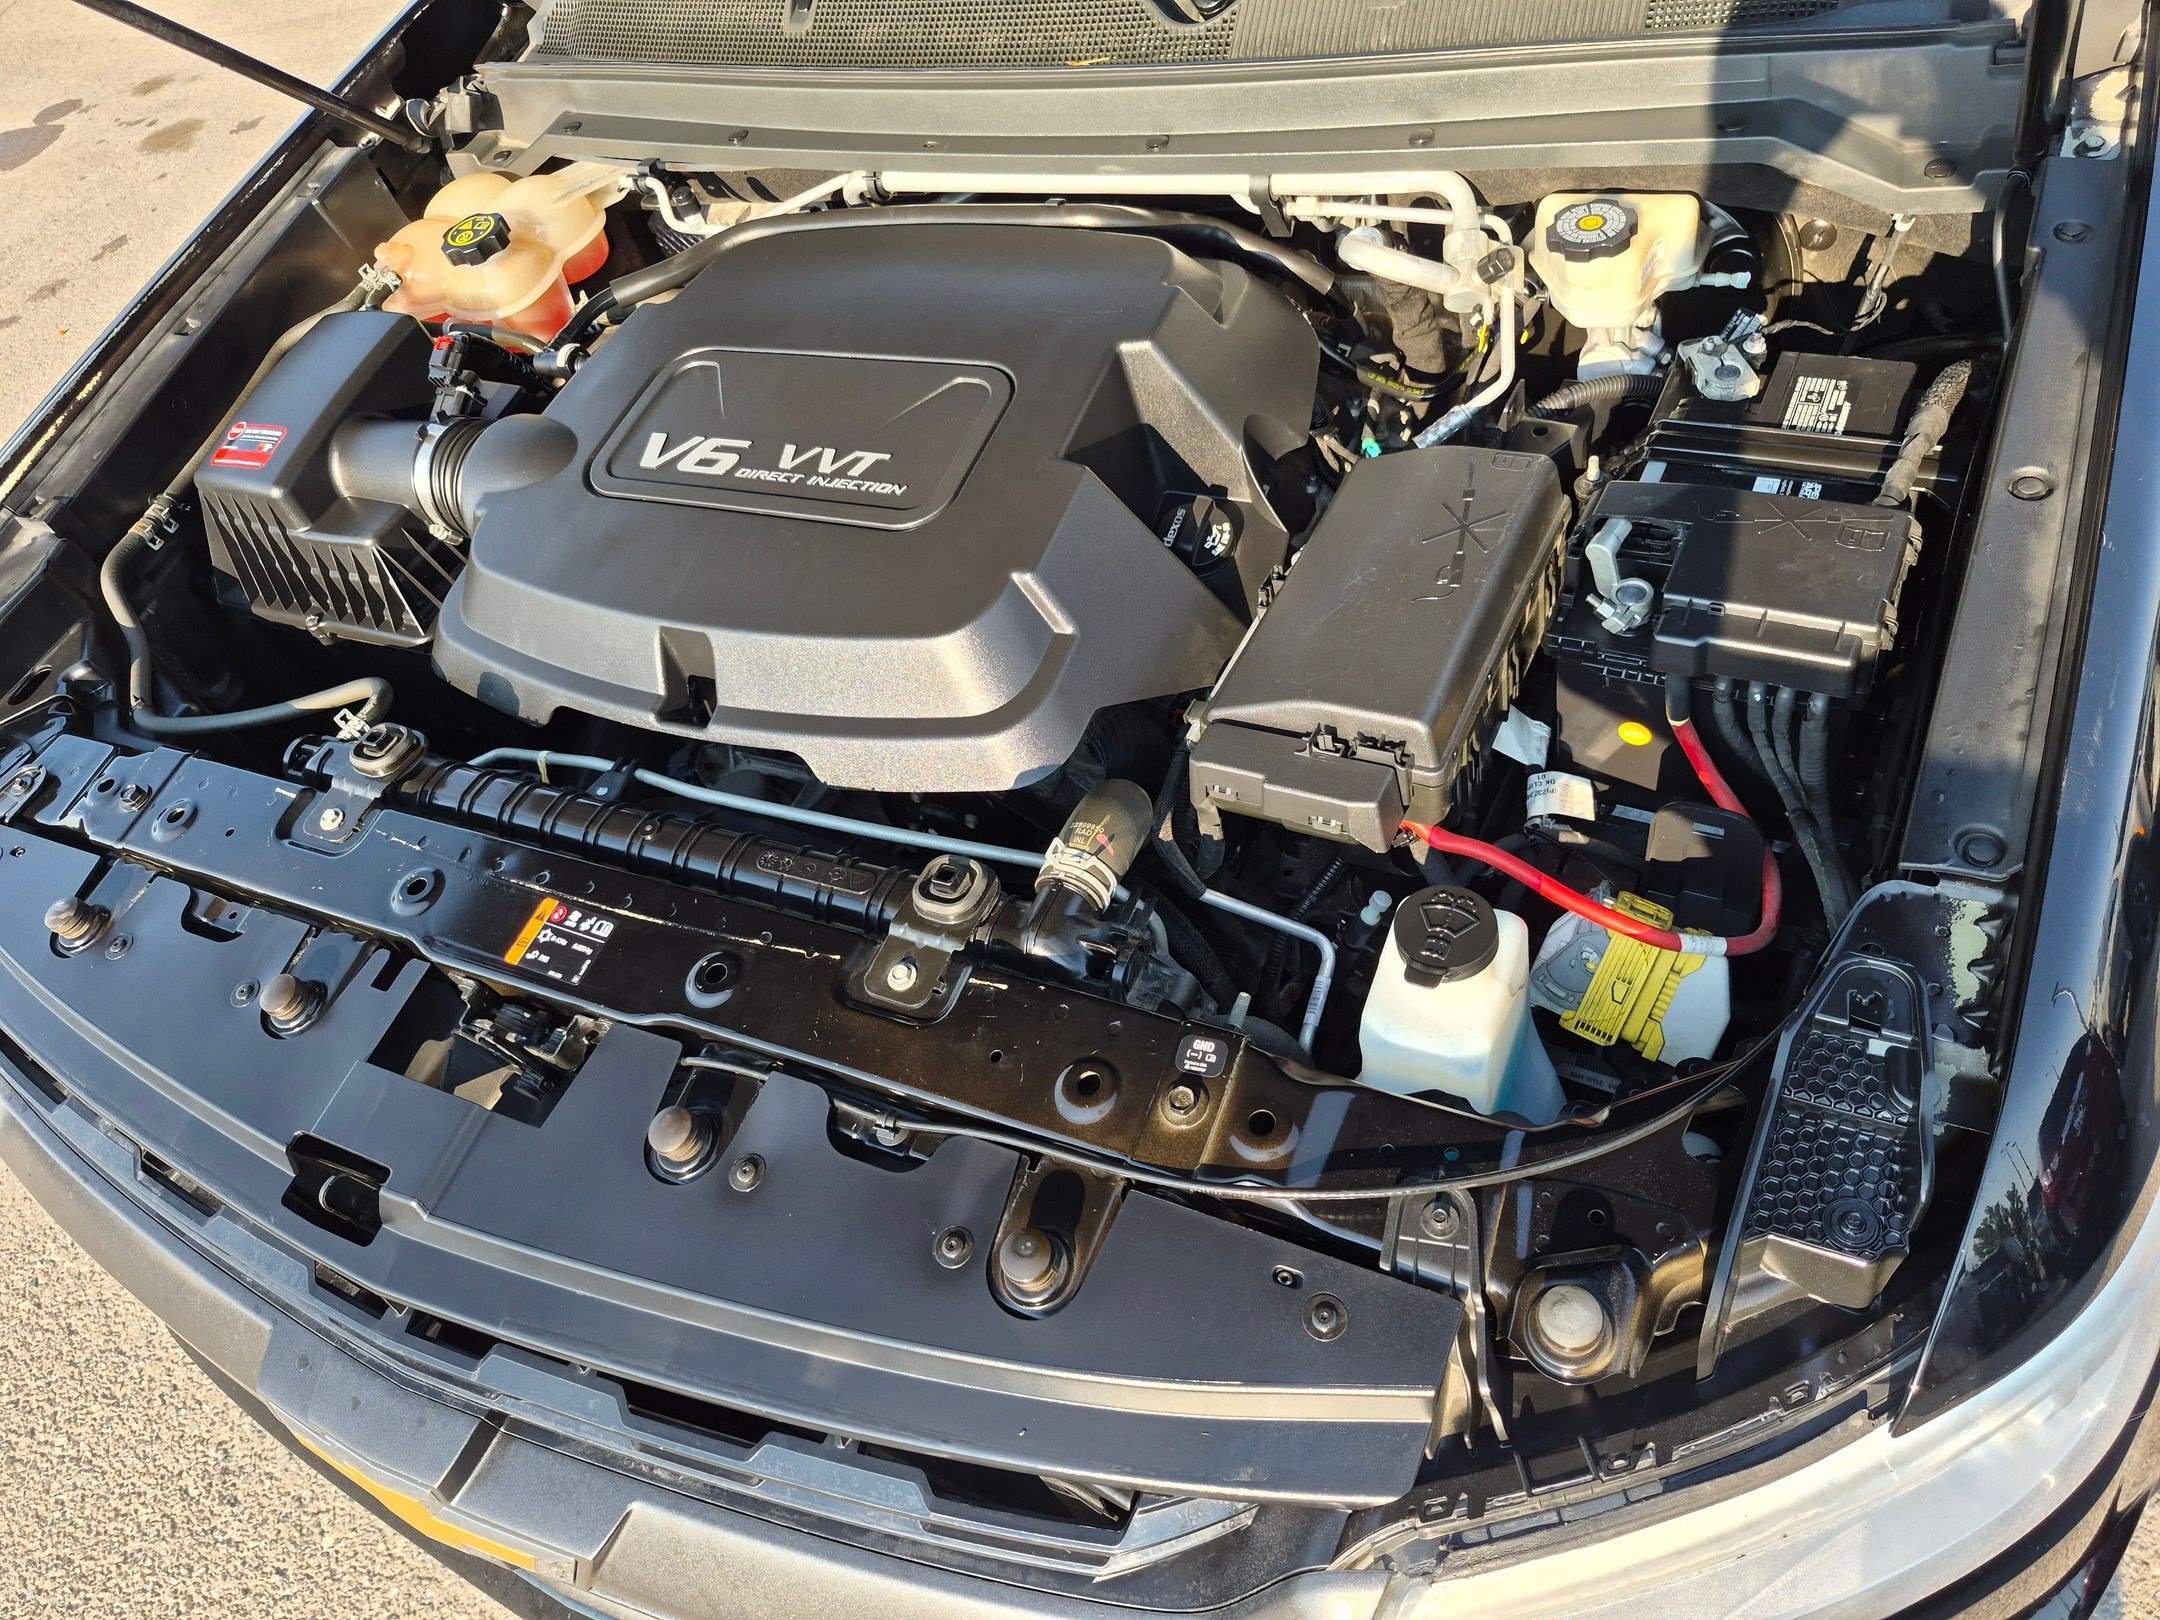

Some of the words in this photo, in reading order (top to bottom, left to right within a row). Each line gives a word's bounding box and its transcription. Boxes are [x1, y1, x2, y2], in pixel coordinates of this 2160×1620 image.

[640, 432, 752, 476] V6
[779, 444, 892, 478] VVT
[734, 467, 805, 484] DIRECT
[806, 475, 907, 496] INJECTION
[1163, 507, 1186, 547] dexos
[1074, 827, 1093, 836] RAD
[1192, 1039, 1216, 1053] GND
